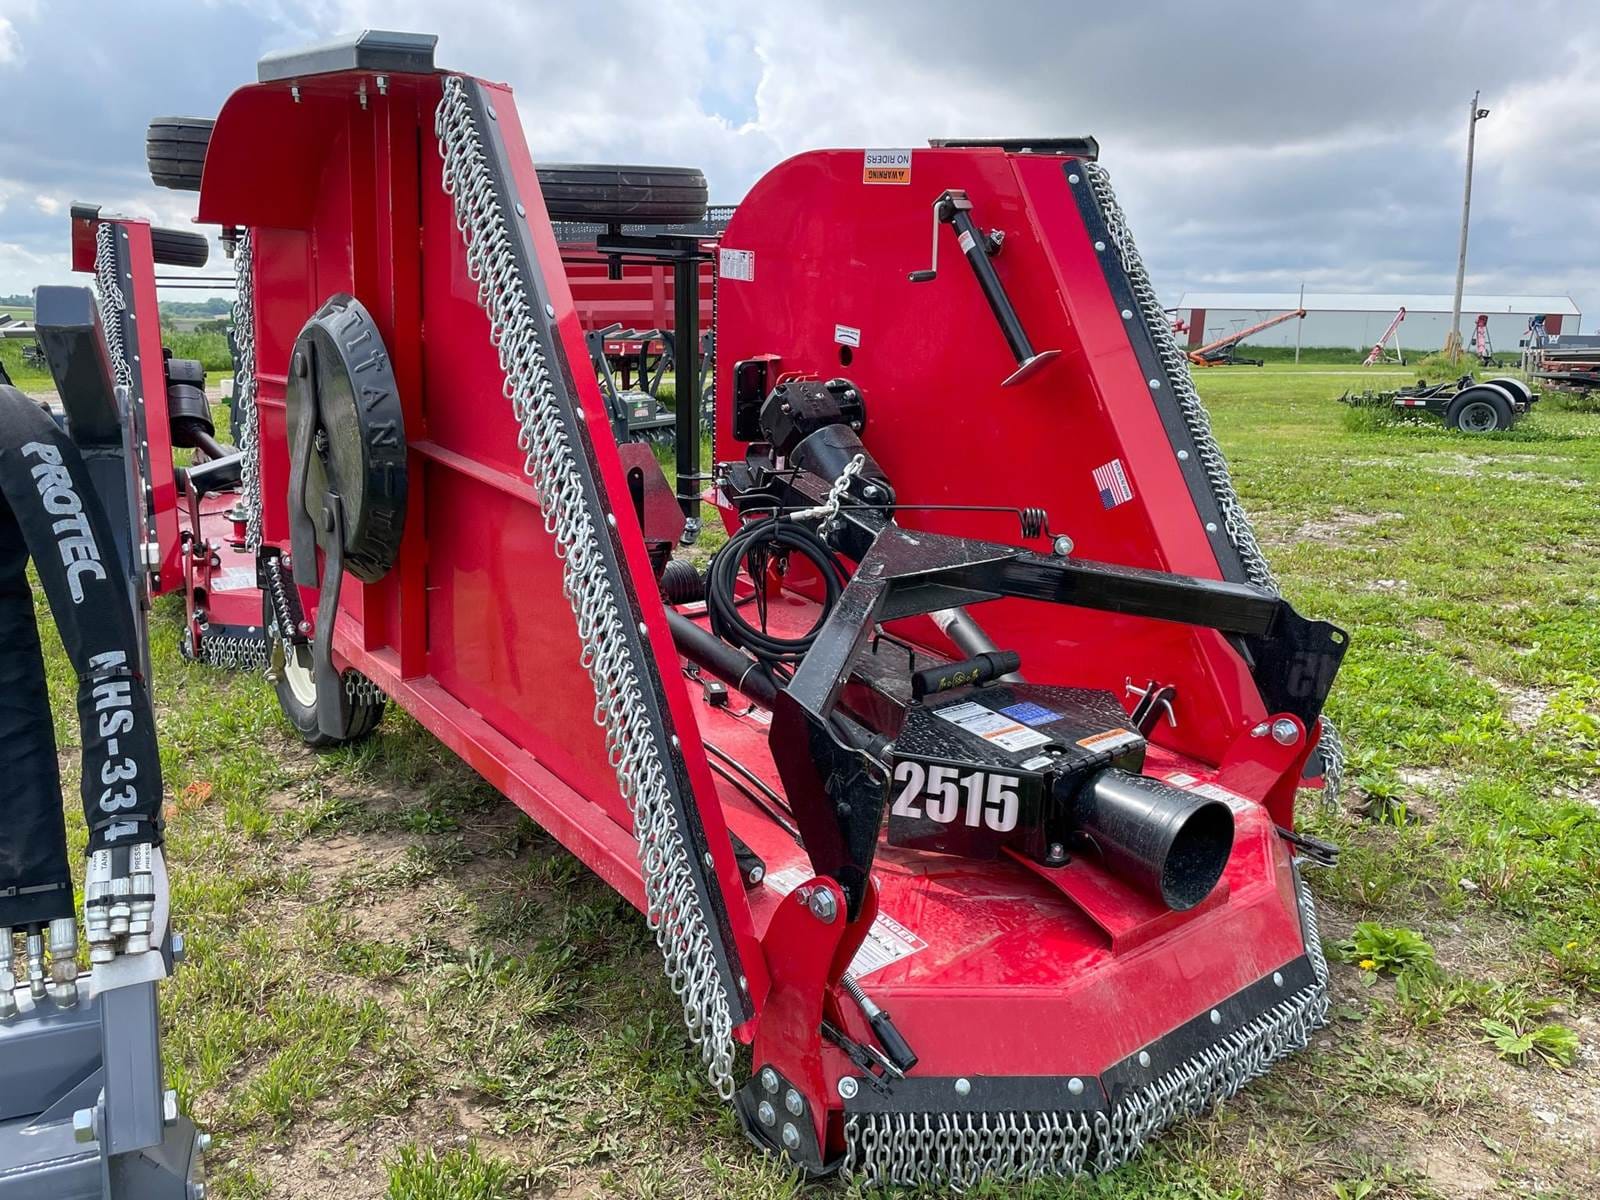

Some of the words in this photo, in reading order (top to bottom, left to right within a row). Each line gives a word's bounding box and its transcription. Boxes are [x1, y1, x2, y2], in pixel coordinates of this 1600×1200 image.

[866, 154, 896, 164] RIDERS
[897, 154, 909, 164] NO
[868, 170, 898, 179] WARNING
[20, 441, 107, 604] PROTEC
[892, 761, 1019, 832] 2515
[876, 913, 916, 944] ANGER
